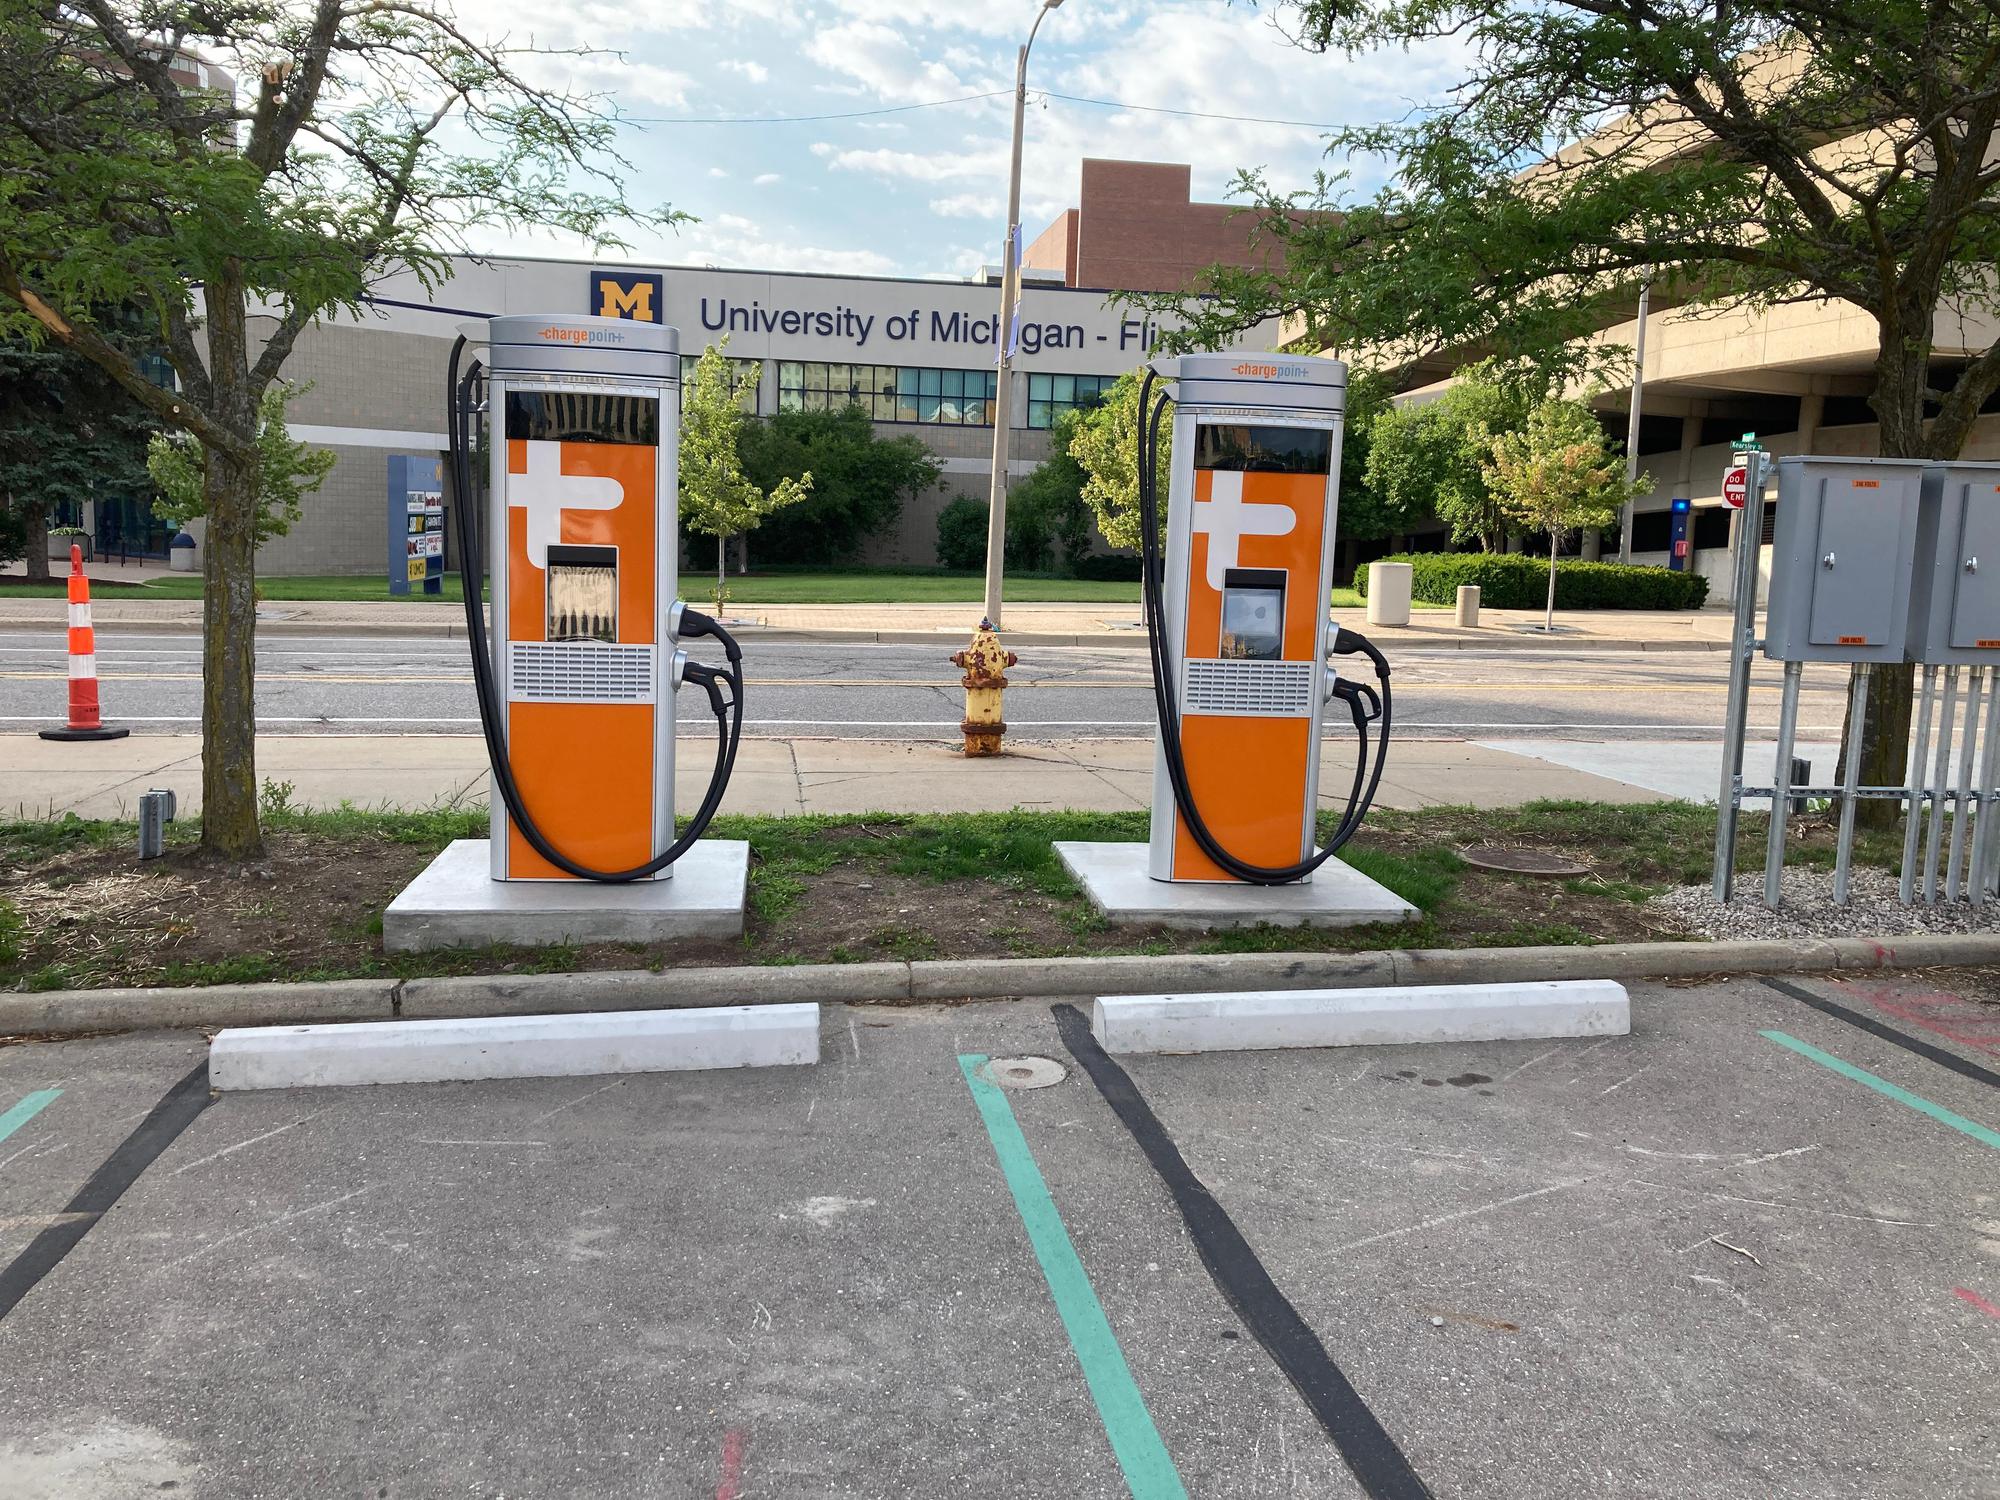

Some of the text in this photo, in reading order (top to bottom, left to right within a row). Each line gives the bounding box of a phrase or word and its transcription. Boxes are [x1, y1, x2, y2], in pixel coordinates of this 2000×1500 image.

[600, 280, 653, 320] M
[701, 298, 874, 346] University
[886, 310, 920, 341] of
[931, 310, 1084, 355] Michgan
[1731, 441, 1756, 450] Kearsley
[1730, 493, 1745, 501] ENT
